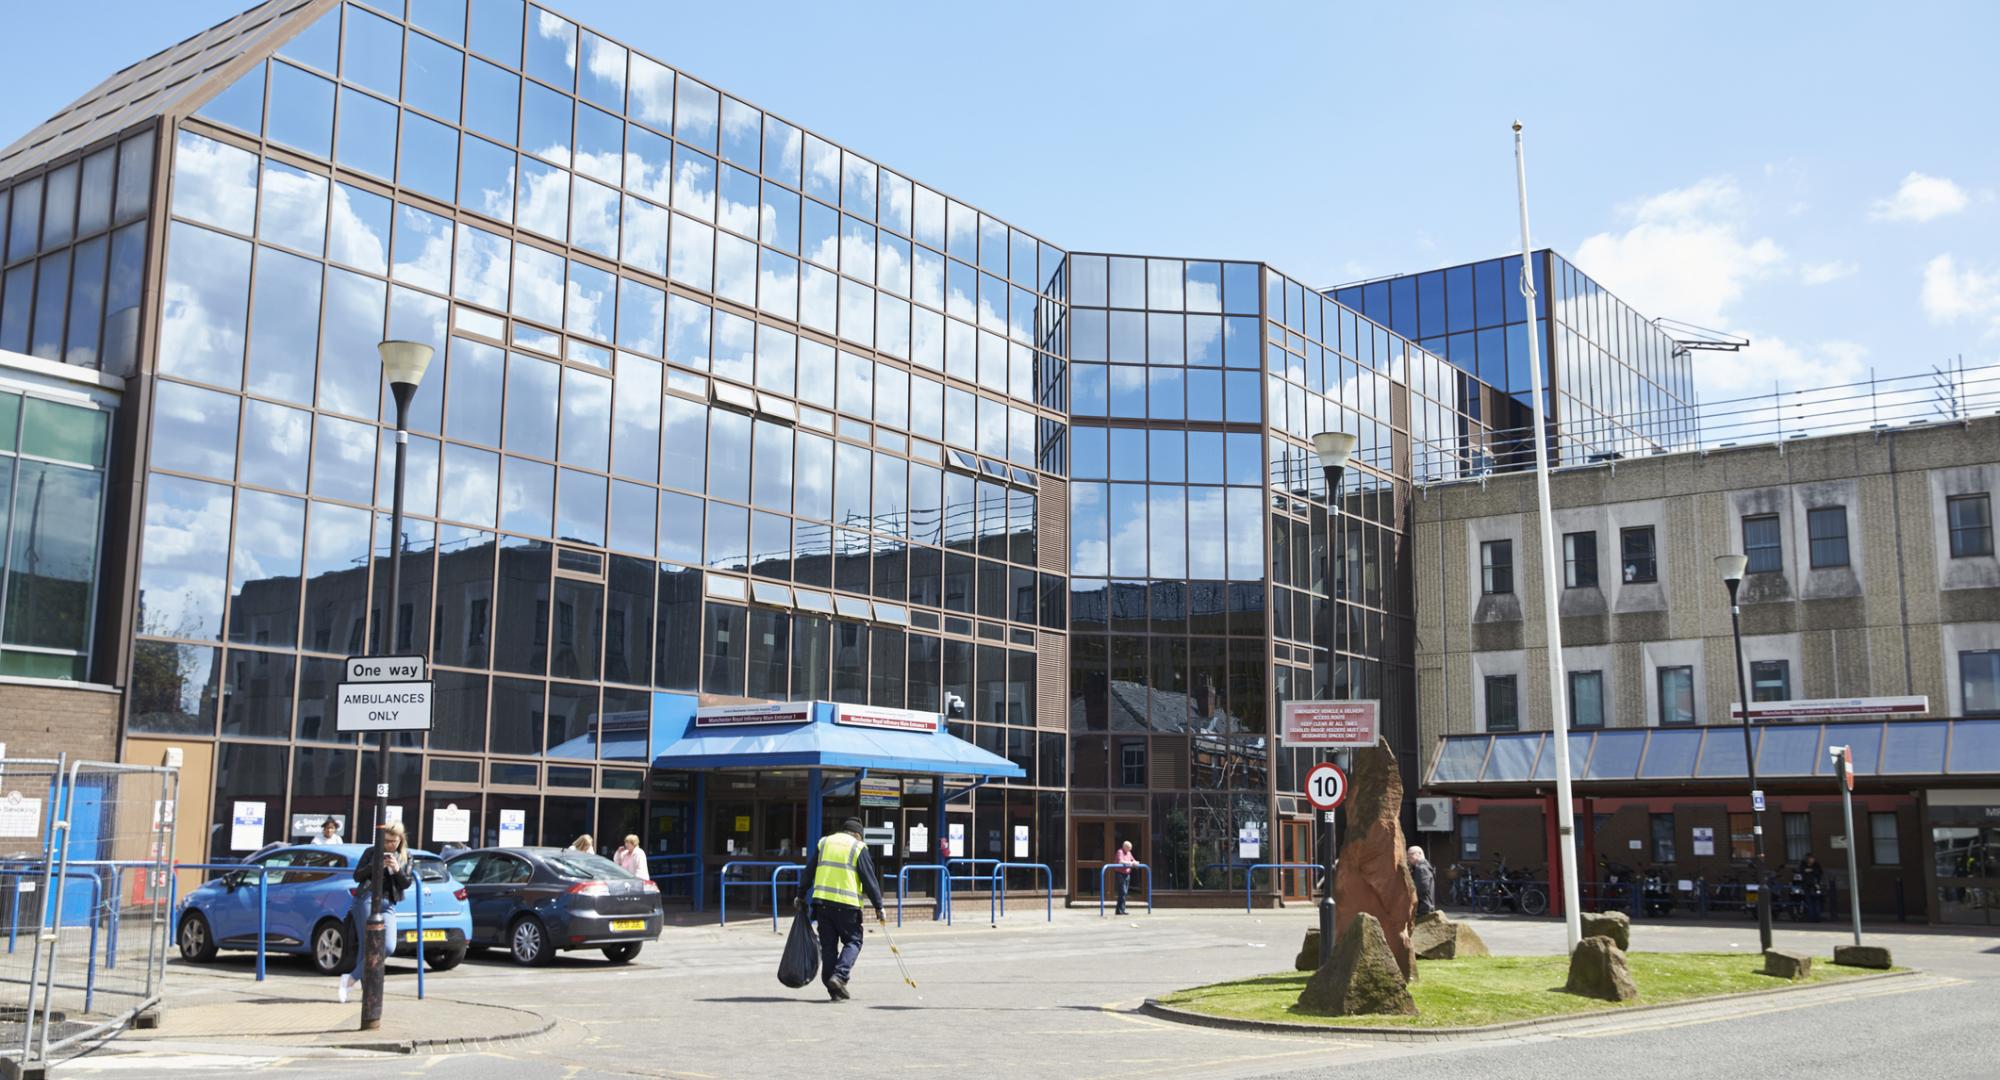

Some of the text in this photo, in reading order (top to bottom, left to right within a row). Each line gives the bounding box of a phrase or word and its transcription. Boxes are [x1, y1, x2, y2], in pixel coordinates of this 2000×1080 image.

[353, 664, 418, 677] One way
[344, 693, 425, 704] AMBULANCES
[368, 711, 399, 721] ONLY
[732, 715, 743, 723] Royal
[744, 714, 763, 722] Infirmary
[775, 712, 793, 720] Entrance
[1314, 777, 1337, 797] 10
